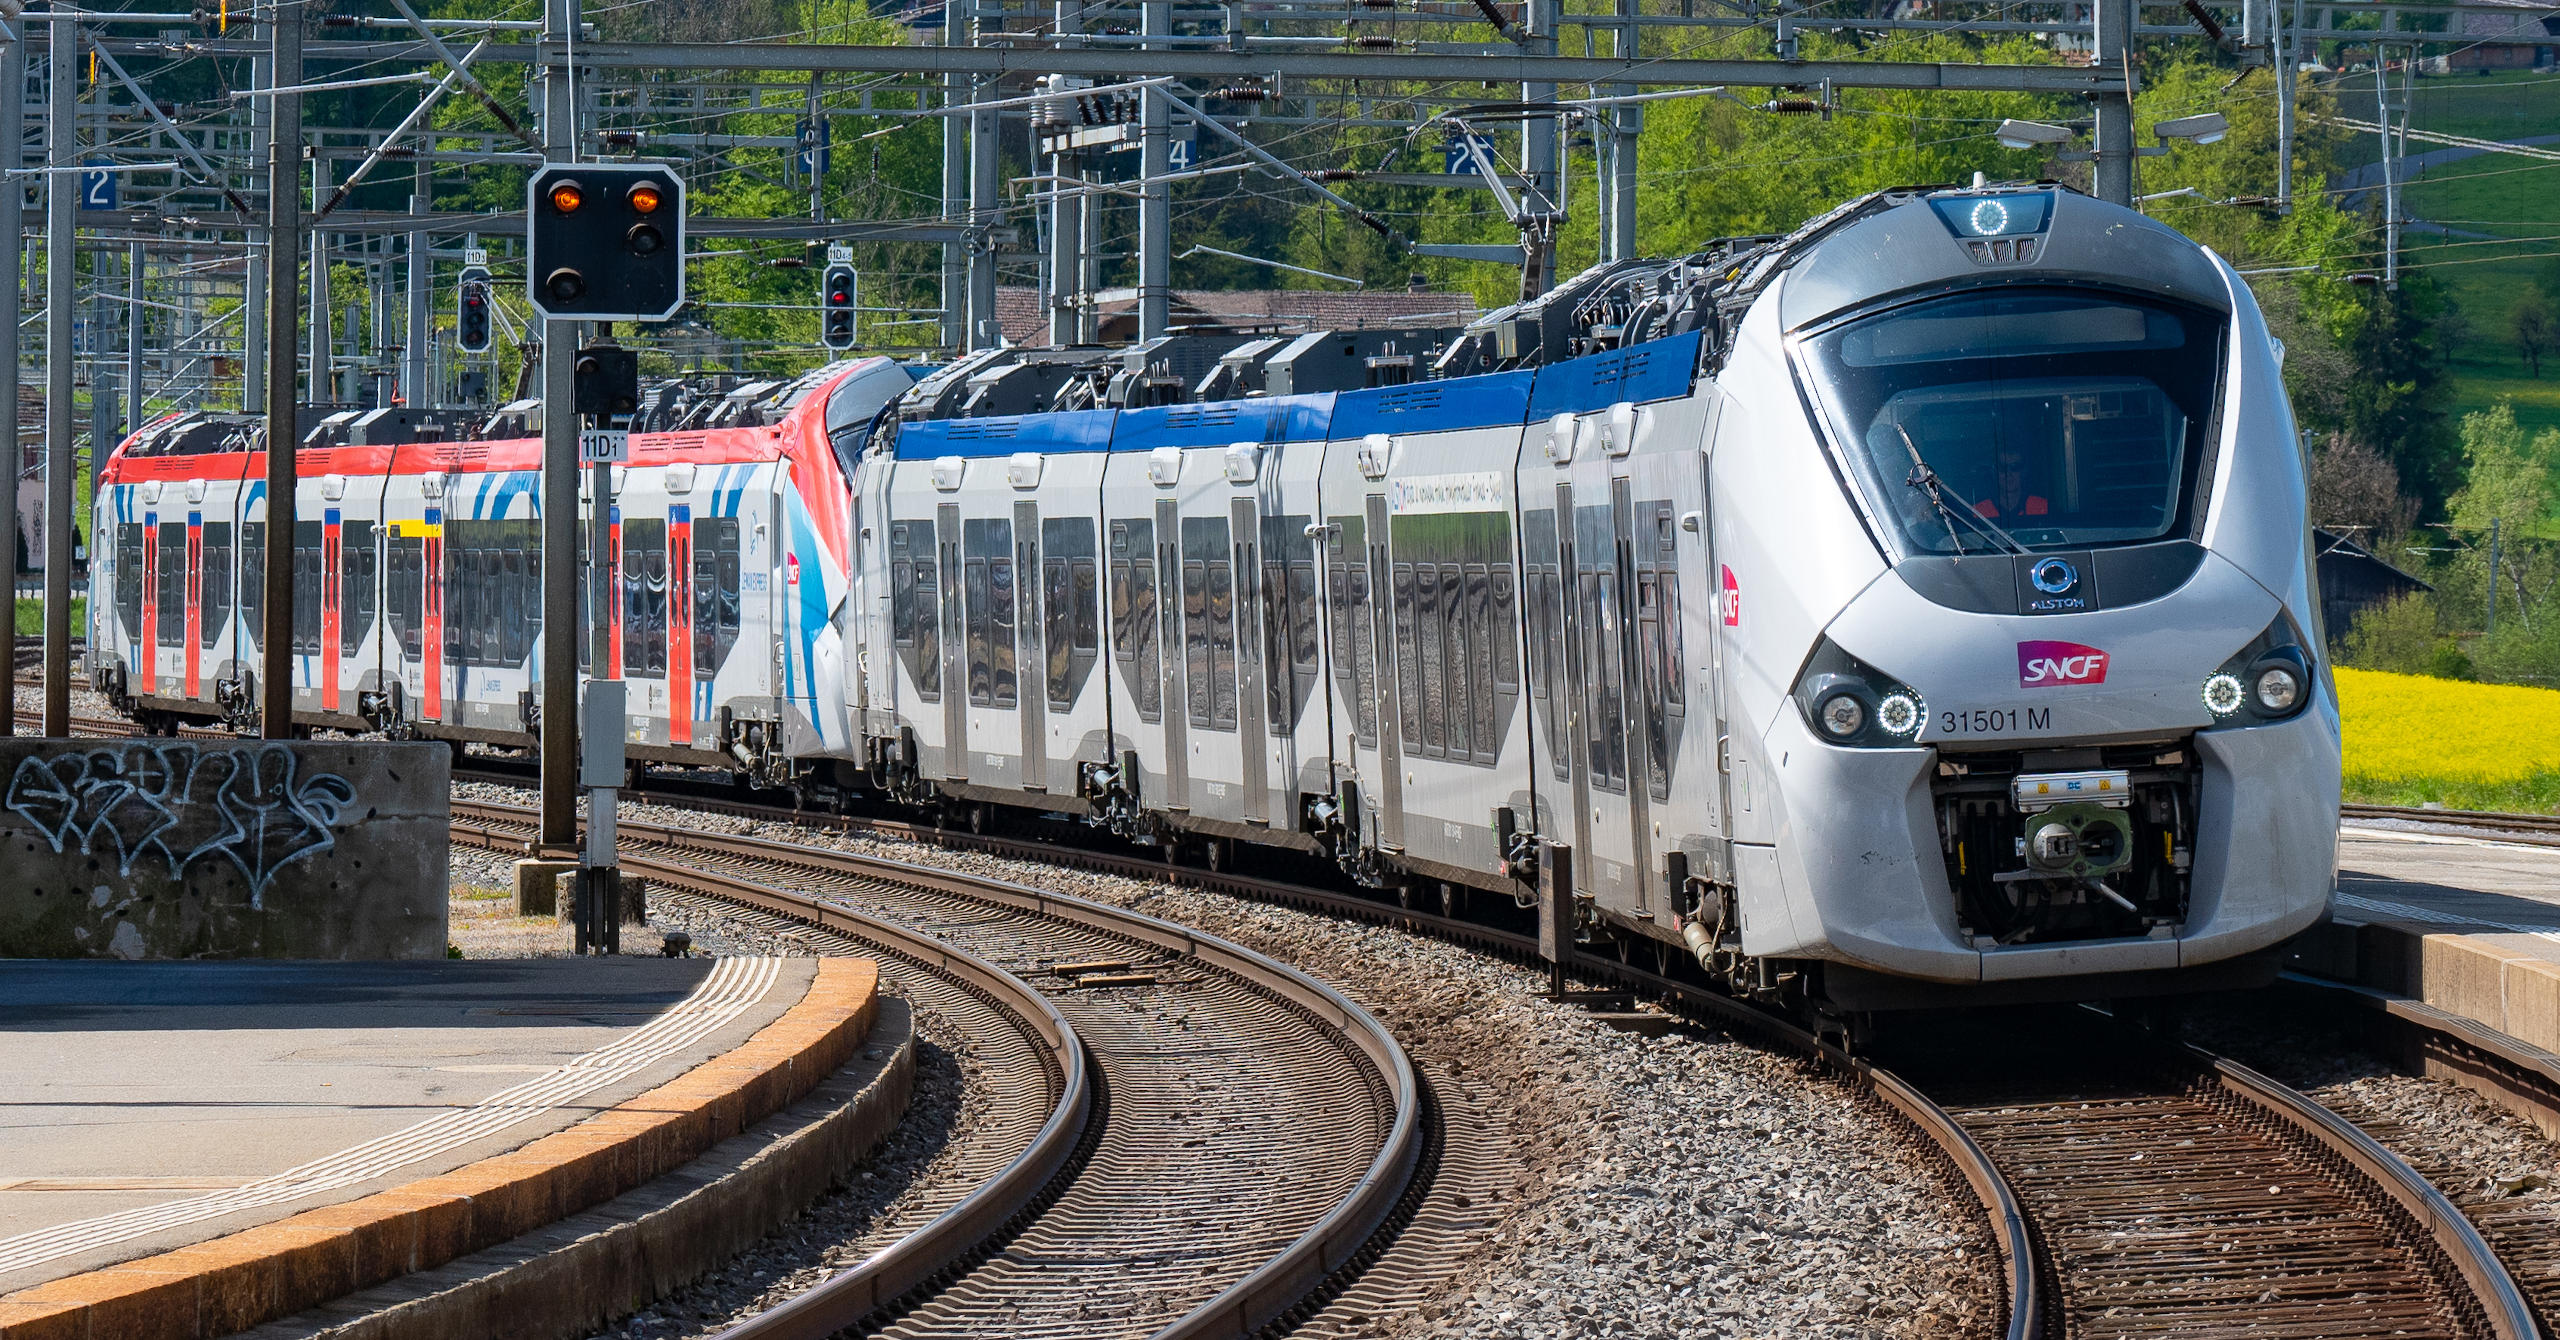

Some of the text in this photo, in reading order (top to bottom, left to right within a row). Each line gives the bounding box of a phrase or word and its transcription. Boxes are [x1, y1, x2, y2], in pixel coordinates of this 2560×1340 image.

[1170, 140, 1189, 171] 4
[89, 169, 108, 204] 2
[2031, 598, 2085, 610] ALSTOM
[2023, 655, 2104, 682] SNCF
[1941, 707, 2050, 733] 31501 M
